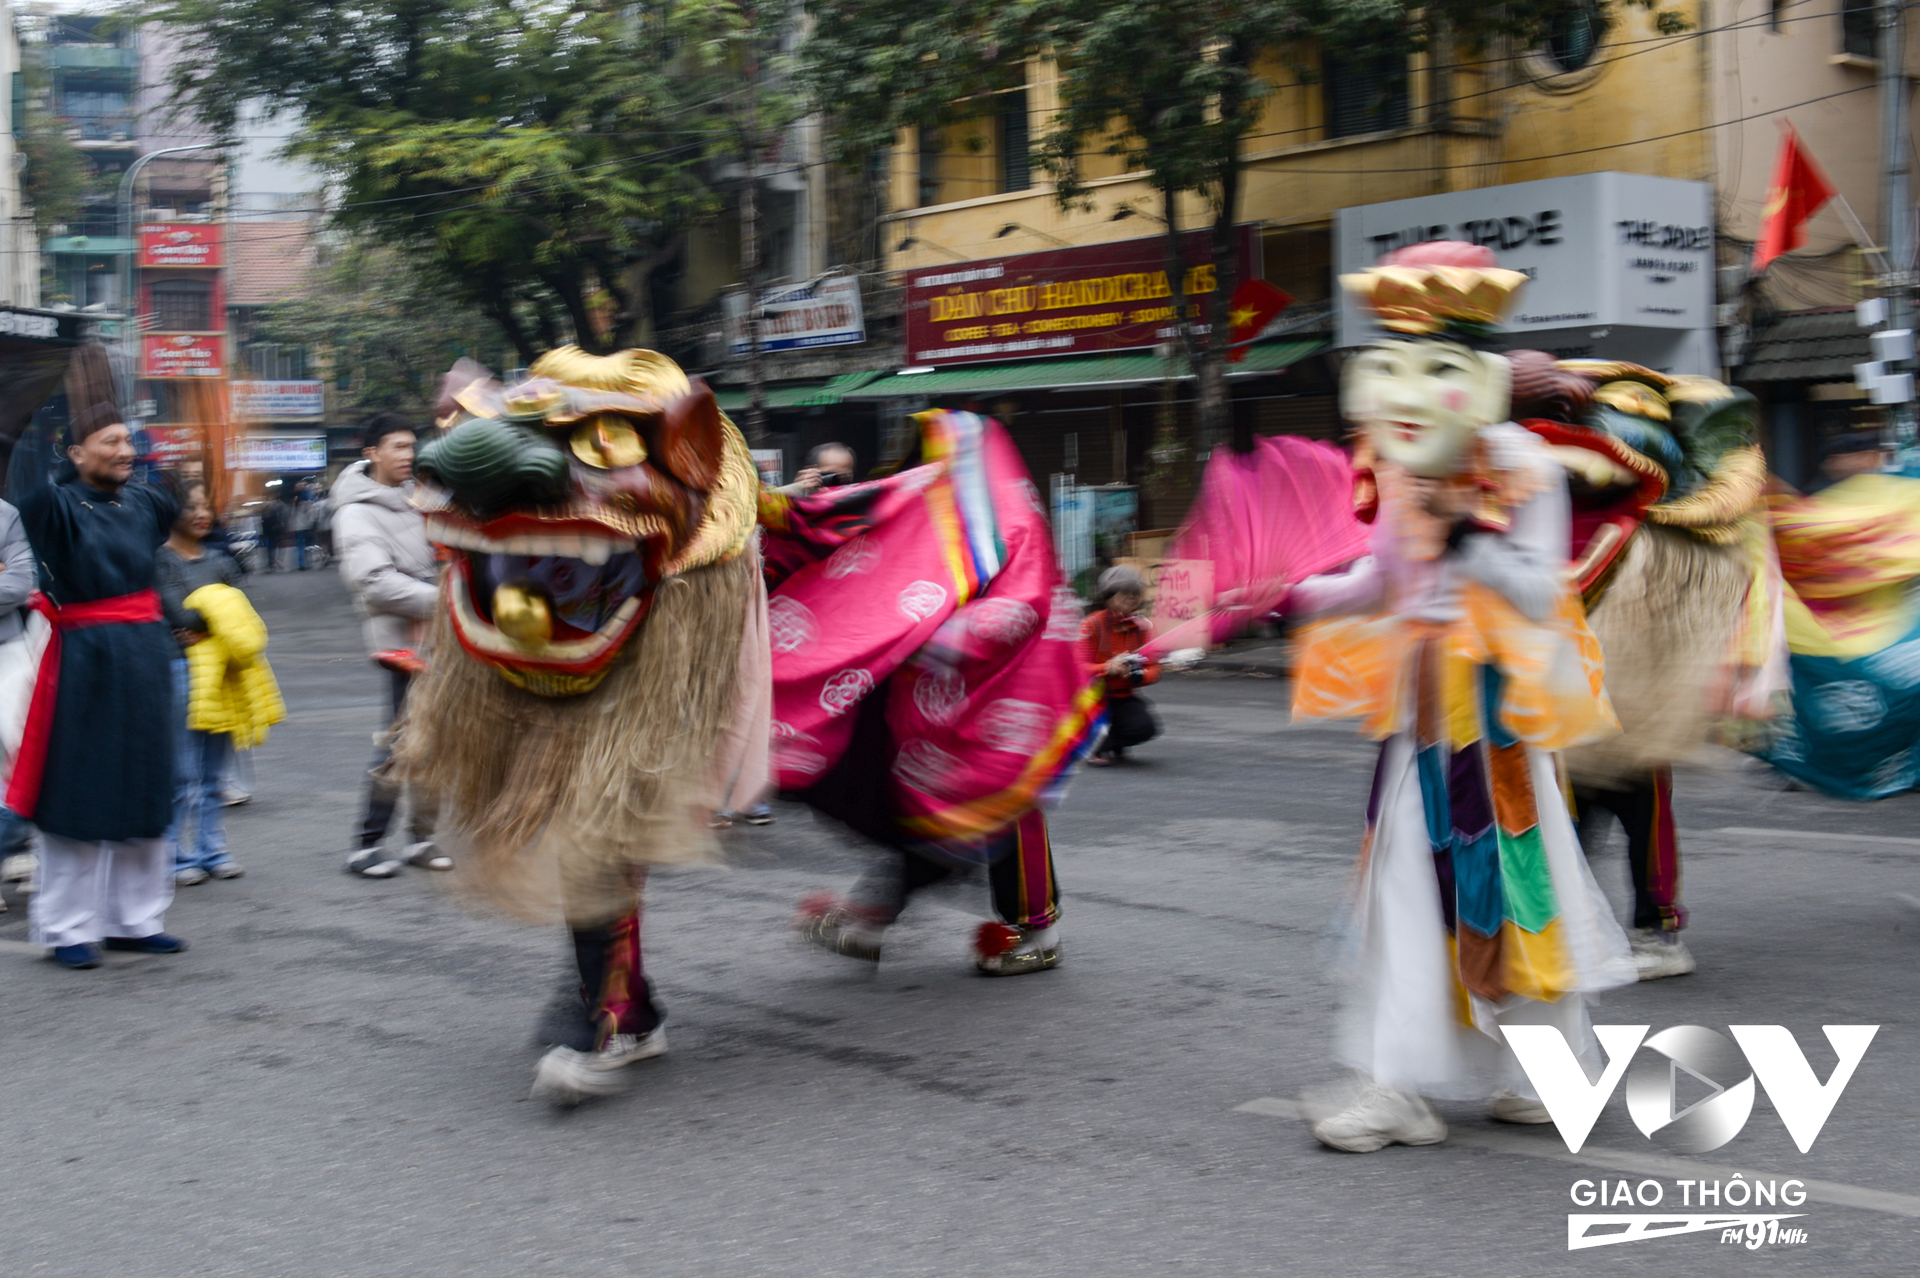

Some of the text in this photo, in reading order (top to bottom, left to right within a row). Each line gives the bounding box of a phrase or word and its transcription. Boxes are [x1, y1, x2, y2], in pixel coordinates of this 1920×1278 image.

[1615, 220, 1710, 250] THE JADE
[930, 286, 984, 322] DÂN
[943, 325, 989, 342] COFFEE
[993, 323, 1020, 337] TEA
